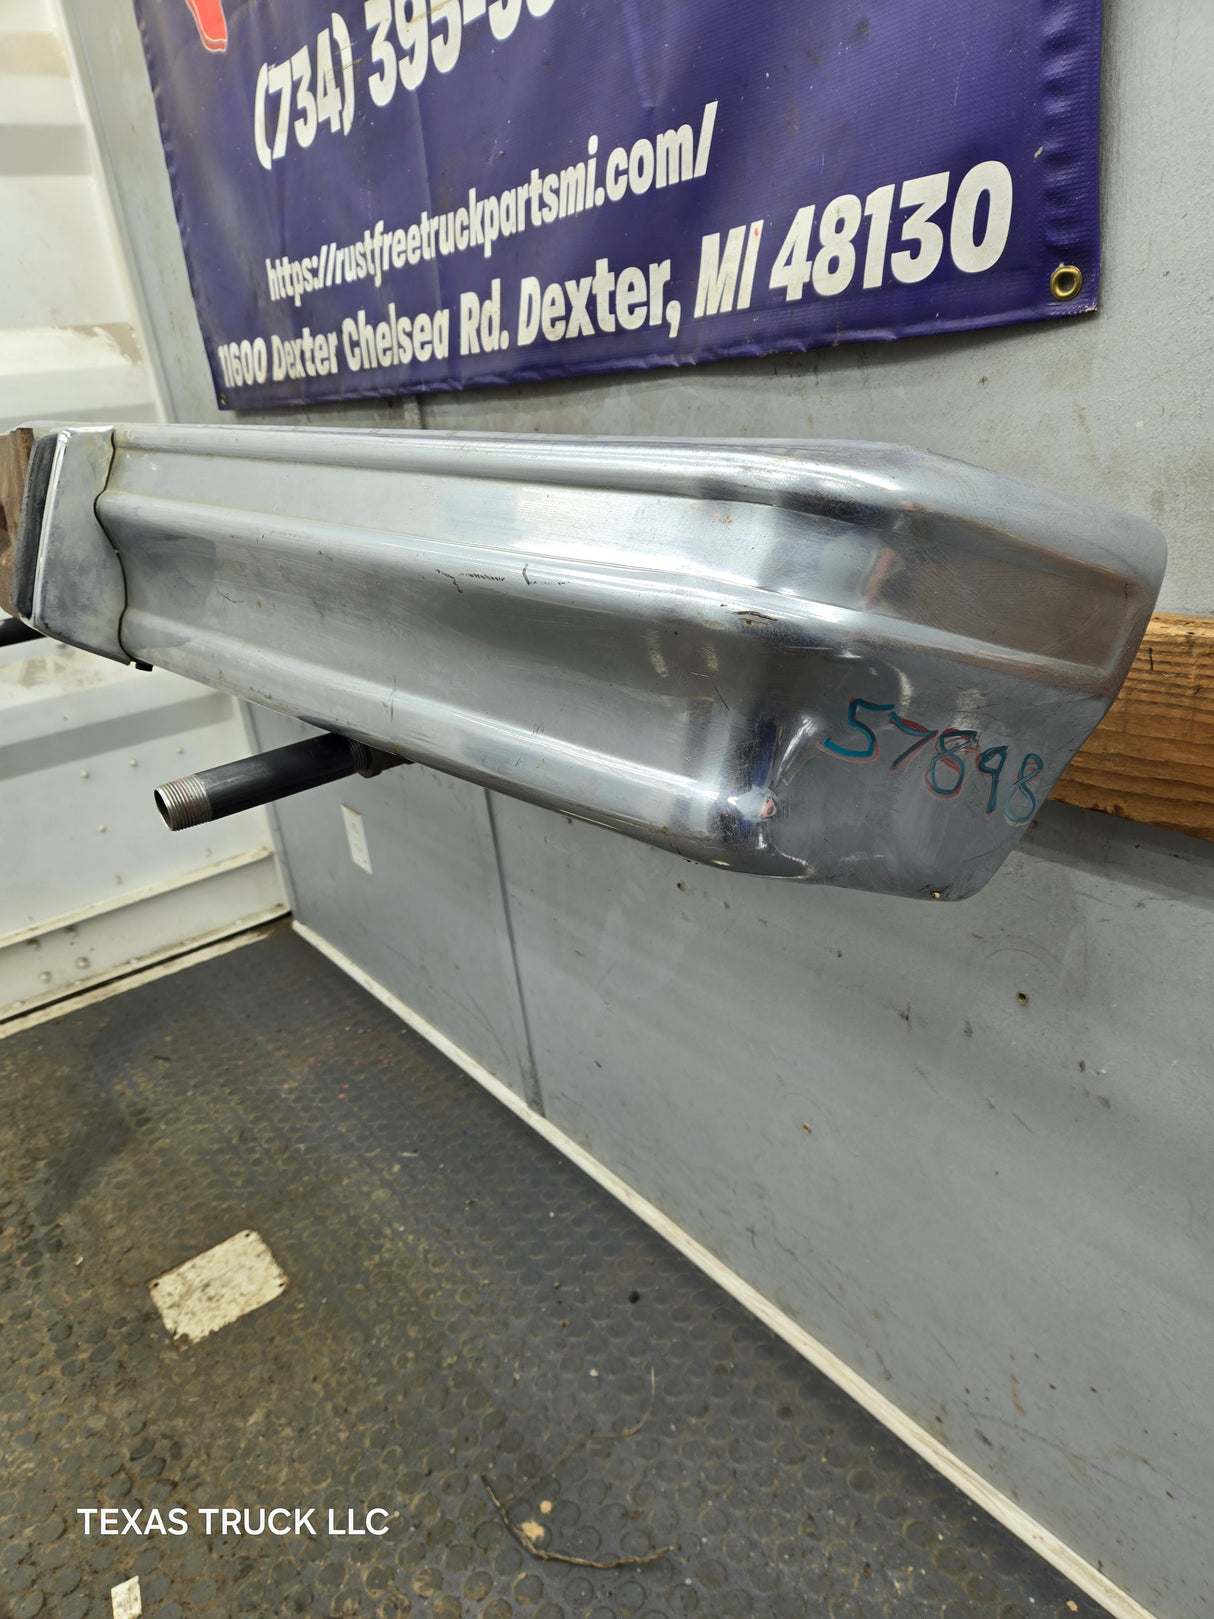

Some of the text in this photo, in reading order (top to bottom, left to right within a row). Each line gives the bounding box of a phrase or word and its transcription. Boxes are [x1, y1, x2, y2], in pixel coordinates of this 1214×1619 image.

[254, 0, 555, 170] (734) 395-
[217, 160, 1013, 388] 11600 Dexter Chelsea Rd. Dexter, MI 48130
[265, 100, 719, 307] https://rustfreetruckpartsmi.com/
[818, 697, 1044, 826] 57898
